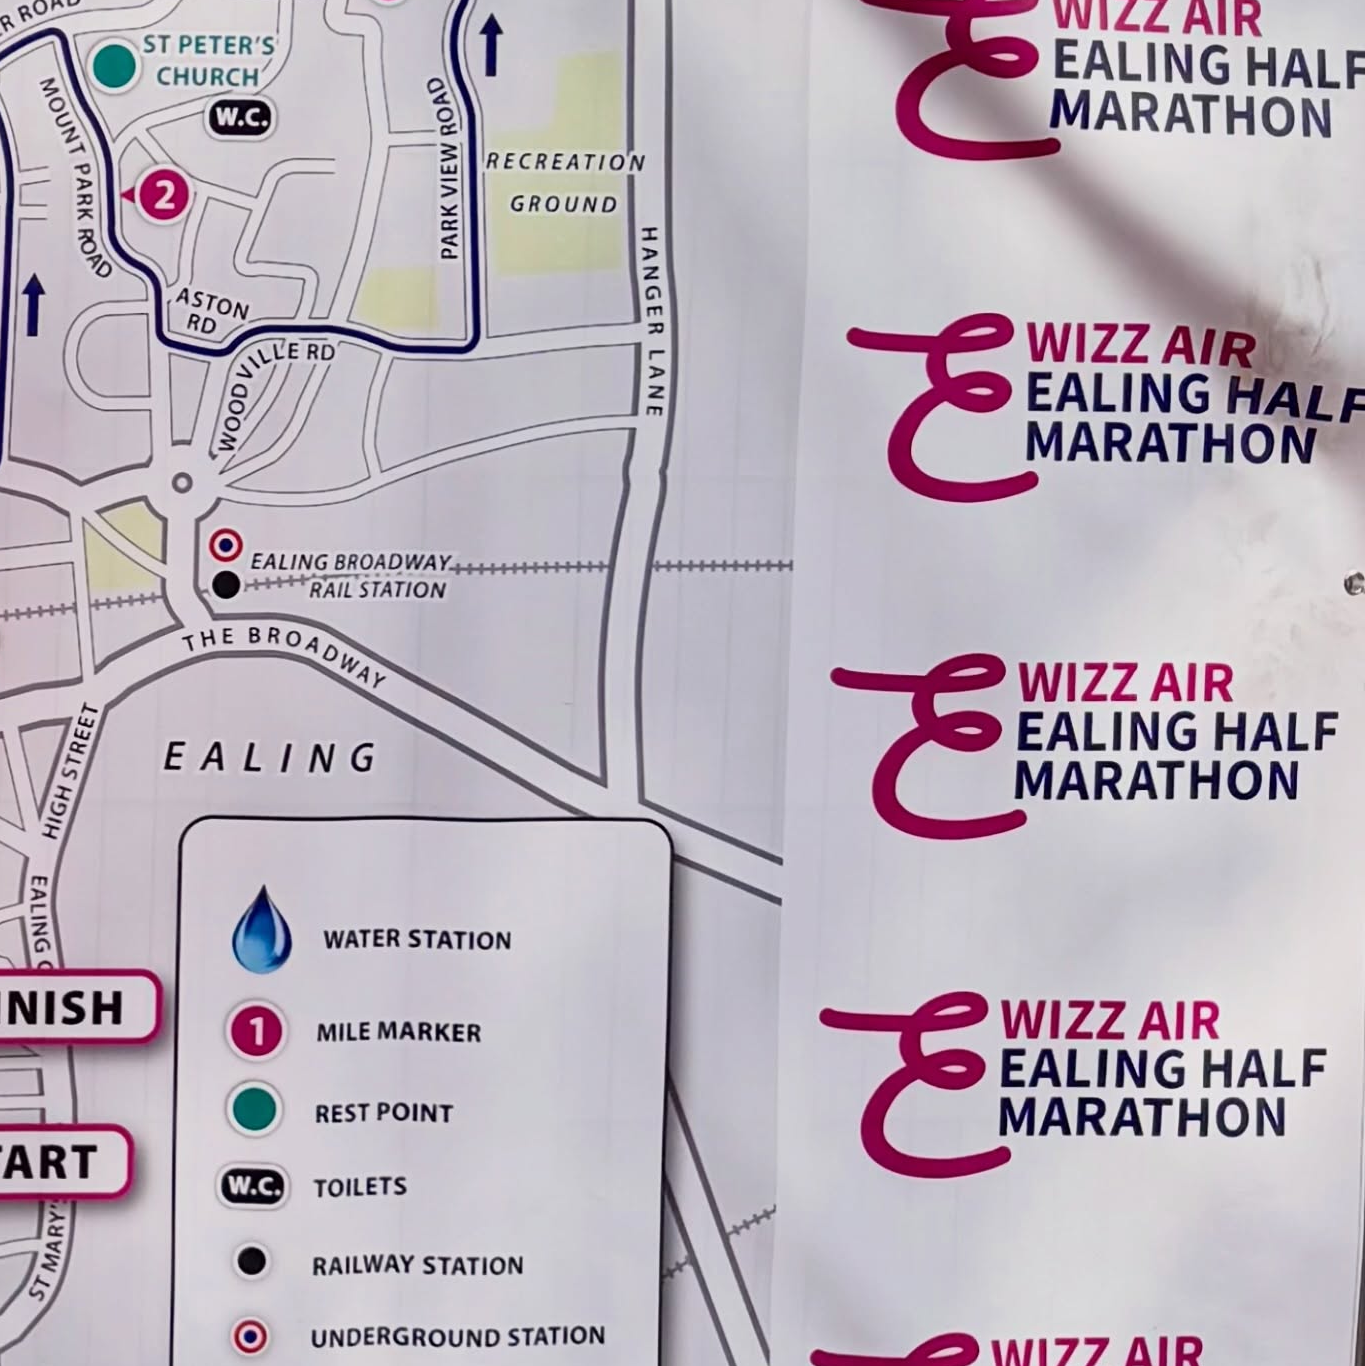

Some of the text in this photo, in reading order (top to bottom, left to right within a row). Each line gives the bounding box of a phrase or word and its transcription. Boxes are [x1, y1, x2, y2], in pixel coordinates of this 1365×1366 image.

[144, 36, 275, 55] ST PETER'S
[157, 67, 259, 87] CHURCH
[216, 106, 269, 127] W.C.
[485, 152, 646, 172] RECREATION
[155, 180, 175, 208] 2
[510, 195, 617, 213] GROUND
[641, 227, 664, 417] HANGER LANE
[251, 553, 452, 572] EALING BROADWAY
[310, 581, 447, 598] RAIL STATION
[182, 627, 386, 690] THE BROADWAY
[1019, 663, 1233, 702] WIZZ AIR
[1017, 711, 1338, 751] EALING HALF
[163, 741, 375, 772] EALING
[1015, 760, 1298, 800] MARATHON
[323, 930, 511, 950] WATER STATION
[249, 1017, 263, 1045] 1
[317, 1022, 481, 1043] MILE MARKER
[316, 1103, 454, 1123] REST POINT
[228, 1176, 281, 1196] W.C.
[314, 1177, 407, 1197] TOILETS
[312, 1255, 524, 1276] RAILWAY STATION
[311, 1326, 605, 1347] UNDERGROUND STATION
